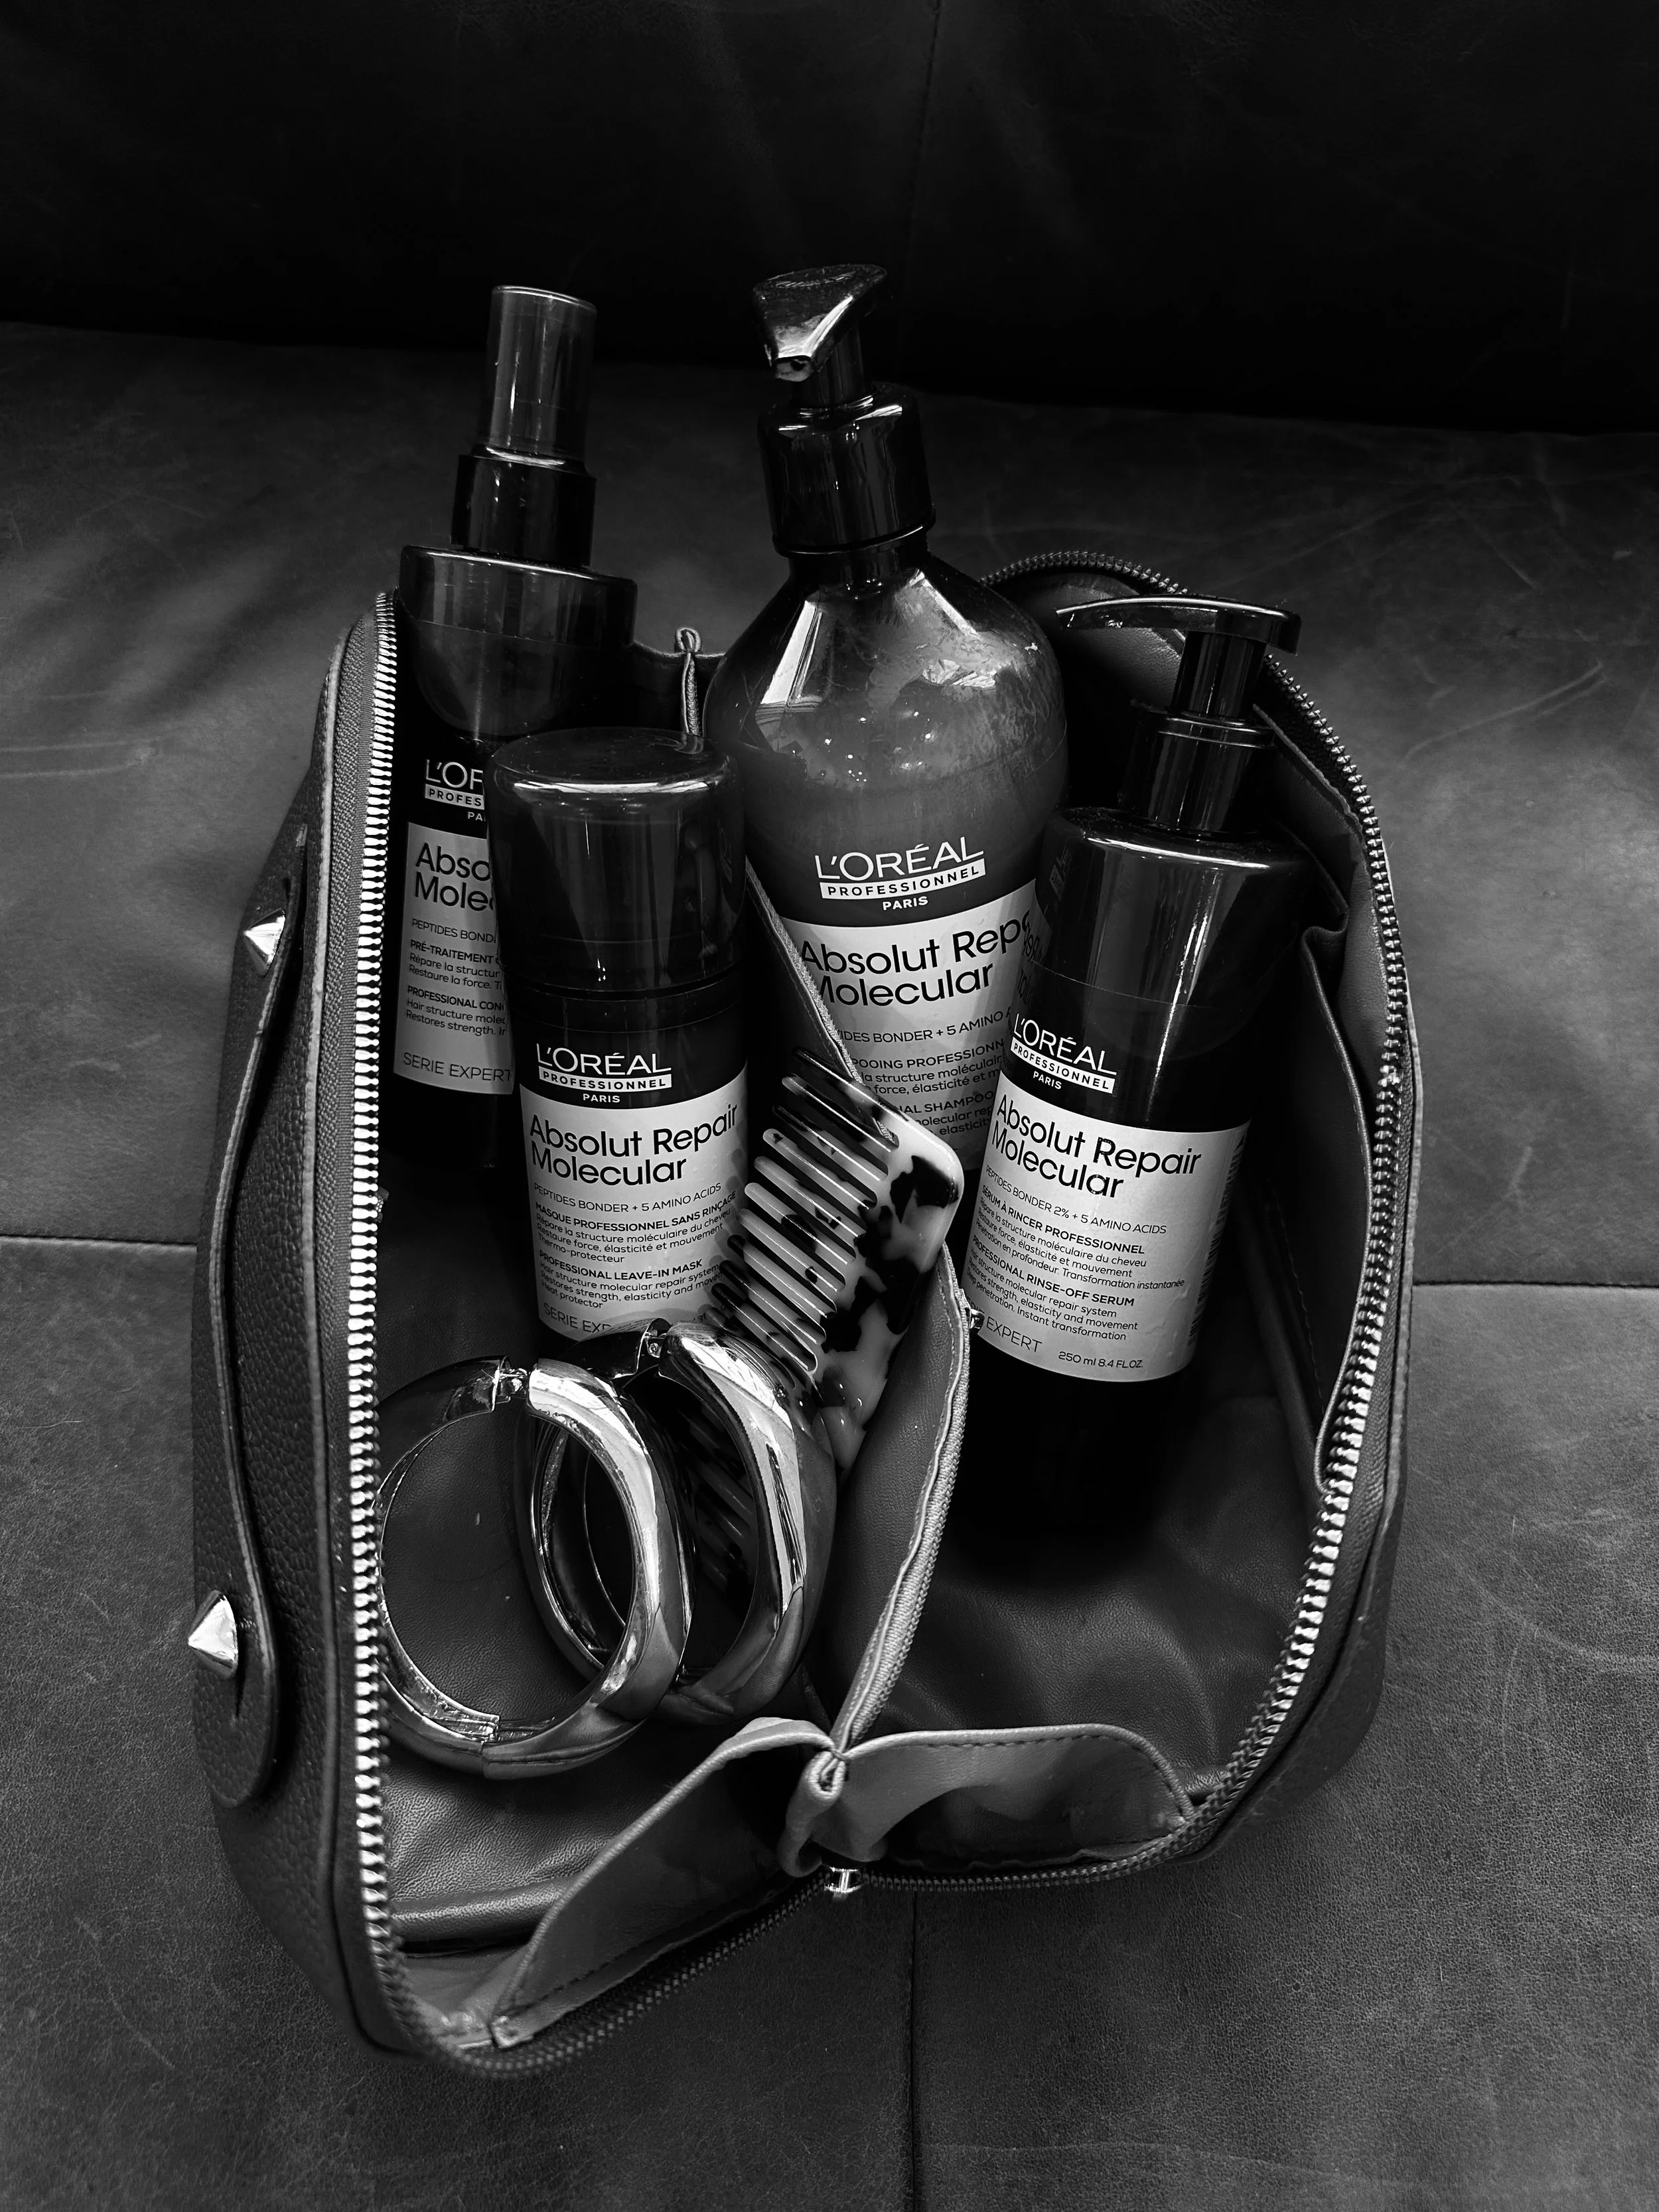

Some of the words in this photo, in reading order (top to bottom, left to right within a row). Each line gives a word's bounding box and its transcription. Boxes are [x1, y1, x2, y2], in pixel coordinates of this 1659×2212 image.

[429, 788, 482, 807] PROFES
[415, 842, 490, 882] Abso
[814, 836, 984, 881] L'ORÉAL
[414, 871, 493, 912] Mole
[828, 865, 980, 897] PROFESSIONNEL
[882, 896, 929, 911] PARIS
[412, 918, 458, 938] PEPTIDES
[461, 930, 496, 943] BOND
[410, 952, 443, 970] Répare
[444, 962, 453, 972] la
[456, 966, 500, 978] structur
[411, 938, 494, 964] PRÉ-TRAITEMENT
[801, 938, 940, 975] Absolut
[409, 964, 449, 983] Restaure
[451, 971, 461, 985] la
[407, 985, 478, 1009] PROFESSIONAL
[479, 1001, 504, 1011] CON
[407, 997, 425, 1011] Hair
[426, 1005, 473, 1021] structure
[406, 1009, 446, 1028] Restores
[873, 1029, 933, 1043] BONDER
[946, 1025, 956, 1036] 5
[959, 1011, 1003, 1033] AMINO
[536, 1043, 672, 1076] L'ORÉAL
[907, 1038, 1005, 1069] PROFESSIONN
[1013, 1013, 1118, 1076] L'ORÉAL
[403, 1051, 445, 1075] SERIE
[875, 1071, 935, 1083] structure
[938, 1055, 1002, 1078] moléculair
[1013, 1043, 1110, 1090] PROFESSIONNEL
[543, 1070, 666, 1090] PROFESSIONNEL
[874, 1084, 910, 1096] force,
[912, 1076, 970, 1094] élasticité
[972, 1070, 985, 1083] et
[1033, 1070, 1062, 1090] PARIS
[583, 1093, 621, 1103] PARIS
[924, 1090, 994, 1113] SHAMPOO
[530, 1114, 643, 1157] Absolut
[653, 1104, 738, 1155] Repair
[997, 1094, 1086, 1158] Absolut
[1092, 1136, 1202, 1178] Repair
[531, 1140, 687, 1186] Molecular
[992, 1120, 1125, 1199] Molecular
[534, 1182, 576, 1207] PEPTIDES
[578, 1199, 629, 1213] BONDER
[641, 1203, 650, 1212] 5
[652, 1196, 691, 1211] AMINO
[692, 1182, 721, 1202] ACIDS
[536, 1202, 571, 1224] MASQUE
[573, 1217, 670, 1232] PROFESSIONNEL
[671, 1211, 701, 1226] SANS
[702, 1191, 736, 1217] RINÇAGE
[985, 1164, 1013, 1193] PEPTIDES
[1013, 1187, 1052, 1213] BONDER
[1053, 1205, 1070, 1219] 2%
[1080, 1214, 1089, 1224] 5
[1089, 1217, 1132, 1232] AMINO
[1132, 1223, 1168, 1234] ACIDS
[536, 1213, 563, 1233] Répare
[565, 1226, 573, 1236] la
[575, 1230, 624, 1244] structure
[626, 1228, 688, 1244] moléculaire
[690, 1222, 702, 1233] du
[703, 1209, 731, 1228] cheveu
[982, 1184, 1001, 1208] SÉRUM
[1001, 1200, 1007, 1213] À
[1008, 1207, 1043, 1232] RINCER
[1045, 1224, 1145, 1254] PROFESSIONNEL
[537, 1222, 571, 1246] Restaure
[573, 1239, 602, 1254] force,
[604, 1244, 654, 1254] élasticité
[656, 1242, 668, 1251] et
[670, 1222, 723, 1248] mouvement
[538, 1232, 625, 1264] Thermo-protecteur
[995, 1211, 1001, 1222] la
[1001, 1218, 1036, 1242] structure
[1037, 1237, 1094, 1261] moléculaire
[1095, 1253, 1110, 1264] du
[1111, 1256, 1147, 1268] cheveu
[998, 1226, 1016, 1246] force,
[1018, 1238, 1057, 1262] élasticité
[1059, 1257, 1070, 1266] et
[1072, 1260, 1133, 1278] mouvement
[539, 1250, 613, 1280] PROFESSIONAL
[614, 1268, 670, 1281] LEAVE-IN
[672, 1258, 703, 1275] MASK
[540, 1261, 554, 1275] Hair
[555, 1272, 598, 1288] structure
[599, 1282, 654, 1291] molecular
[655, 1274, 686, 1291] repair
[972, 1234, 1025, 1280] PROFESSIONAL
[1026, 1273, 1090, 1300] RINSE-OFF
[1091, 1293, 1135, 1307] SERUM
[1002, 1244, 1011, 1254] en
[1062, 1267, 1135, 1290] Transformation
[1137, 1278, 1185, 1290] instantanée
[541, 1269, 574, 1293] Restores
[575, 1288, 622, 1303] strength,
[623, 1289, 672, 1301] elasticity
[674, 1284, 693, 1296] and
[541, 1280, 559, 1297] Heat
[560, 1291, 604, 1310] protector
[978, 1258, 1005, 1282] structure
[1005, 1278, 1048, 1301] molecular
[1048, 1297, 1080, 1311] repair
[1080, 1305, 1118, 1319] system
[543, 1302, 579, 1329] SERIE
[987, 1278, 1019, 1303] strength,
[1020, 1297, 1062, 1321] elasticity
[1063, 1313, 1084, 1325] and
[1085, 1317, 1139, 1331] movement
[986, 1315, 1043, 1353] EXPERT
[1017, 1305, 1050, 1327] Instant
[1051, 1319, 1127, 1341] transformation
[1058, 1351, 1082, 1363] 250
[1082, 1357, 1097, 1366] ml
[1098, 1358, 1115, 1368] 8.4
